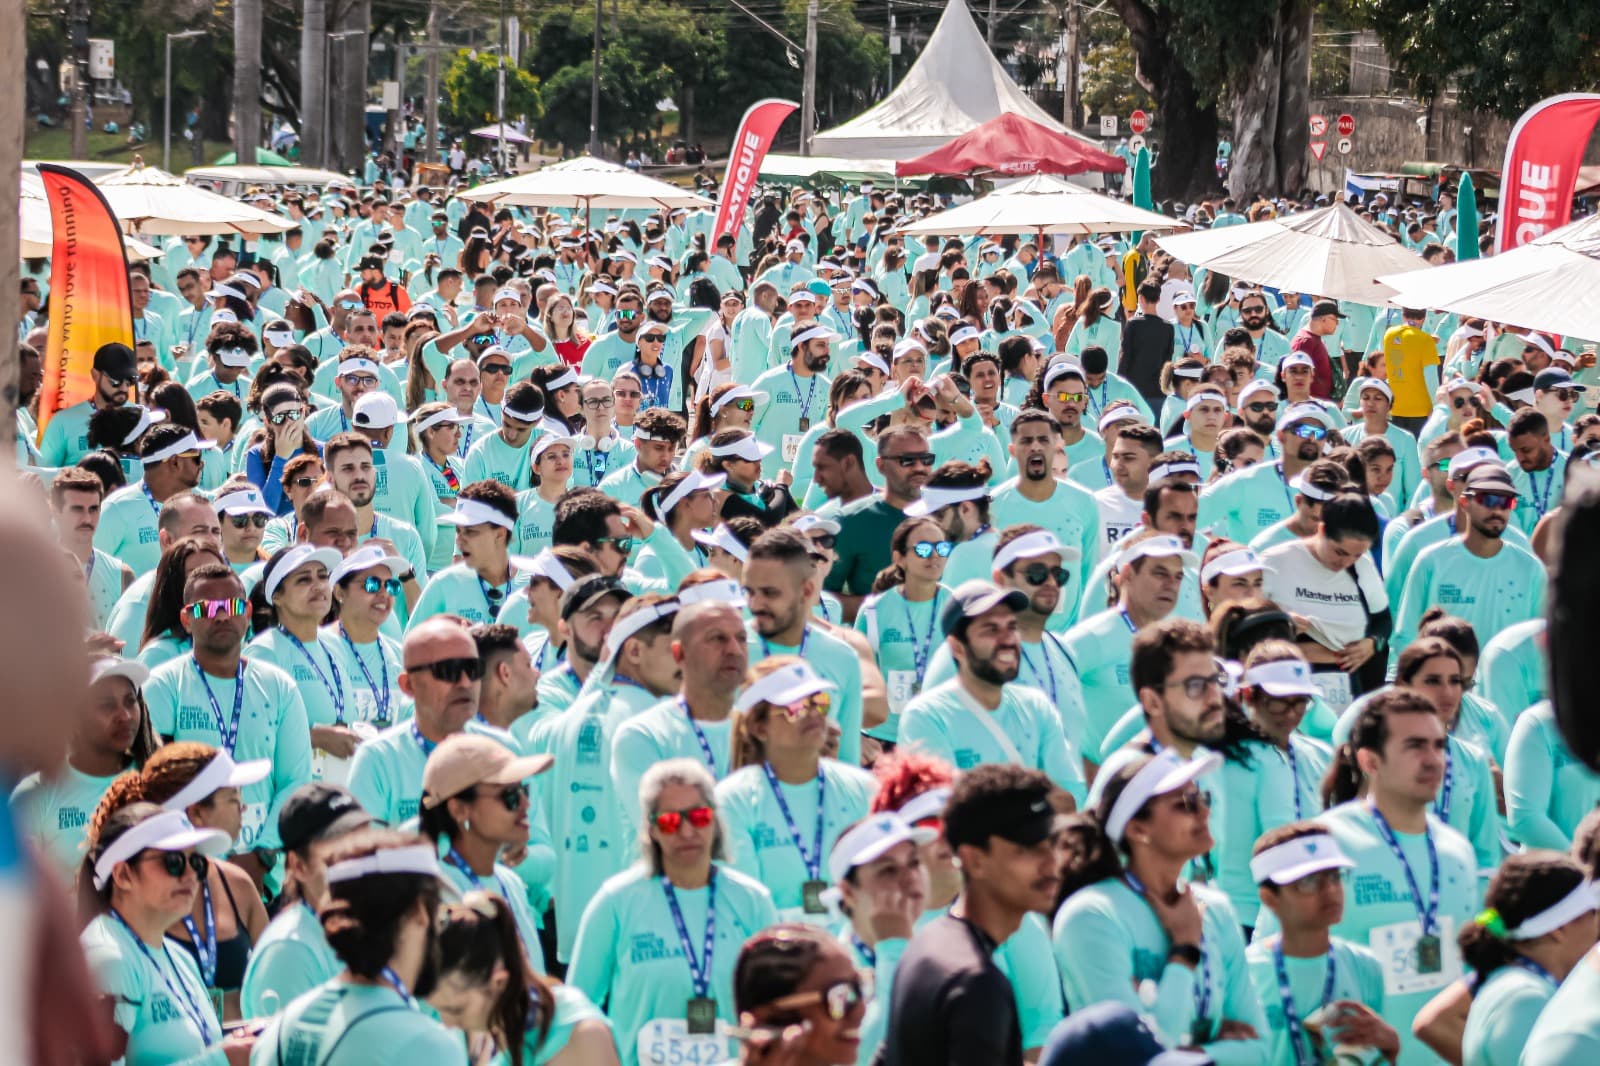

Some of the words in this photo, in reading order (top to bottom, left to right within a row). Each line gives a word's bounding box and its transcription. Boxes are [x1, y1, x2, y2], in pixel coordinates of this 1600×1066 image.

[1132, 118, 1145, 126] PARE
[1339, 122, 1353, 130] PARE
[1295, 587, 1333, 602] Master
[180, 711, 210, 721] CINCO
[650, 1039, 720, 1065] 5542
